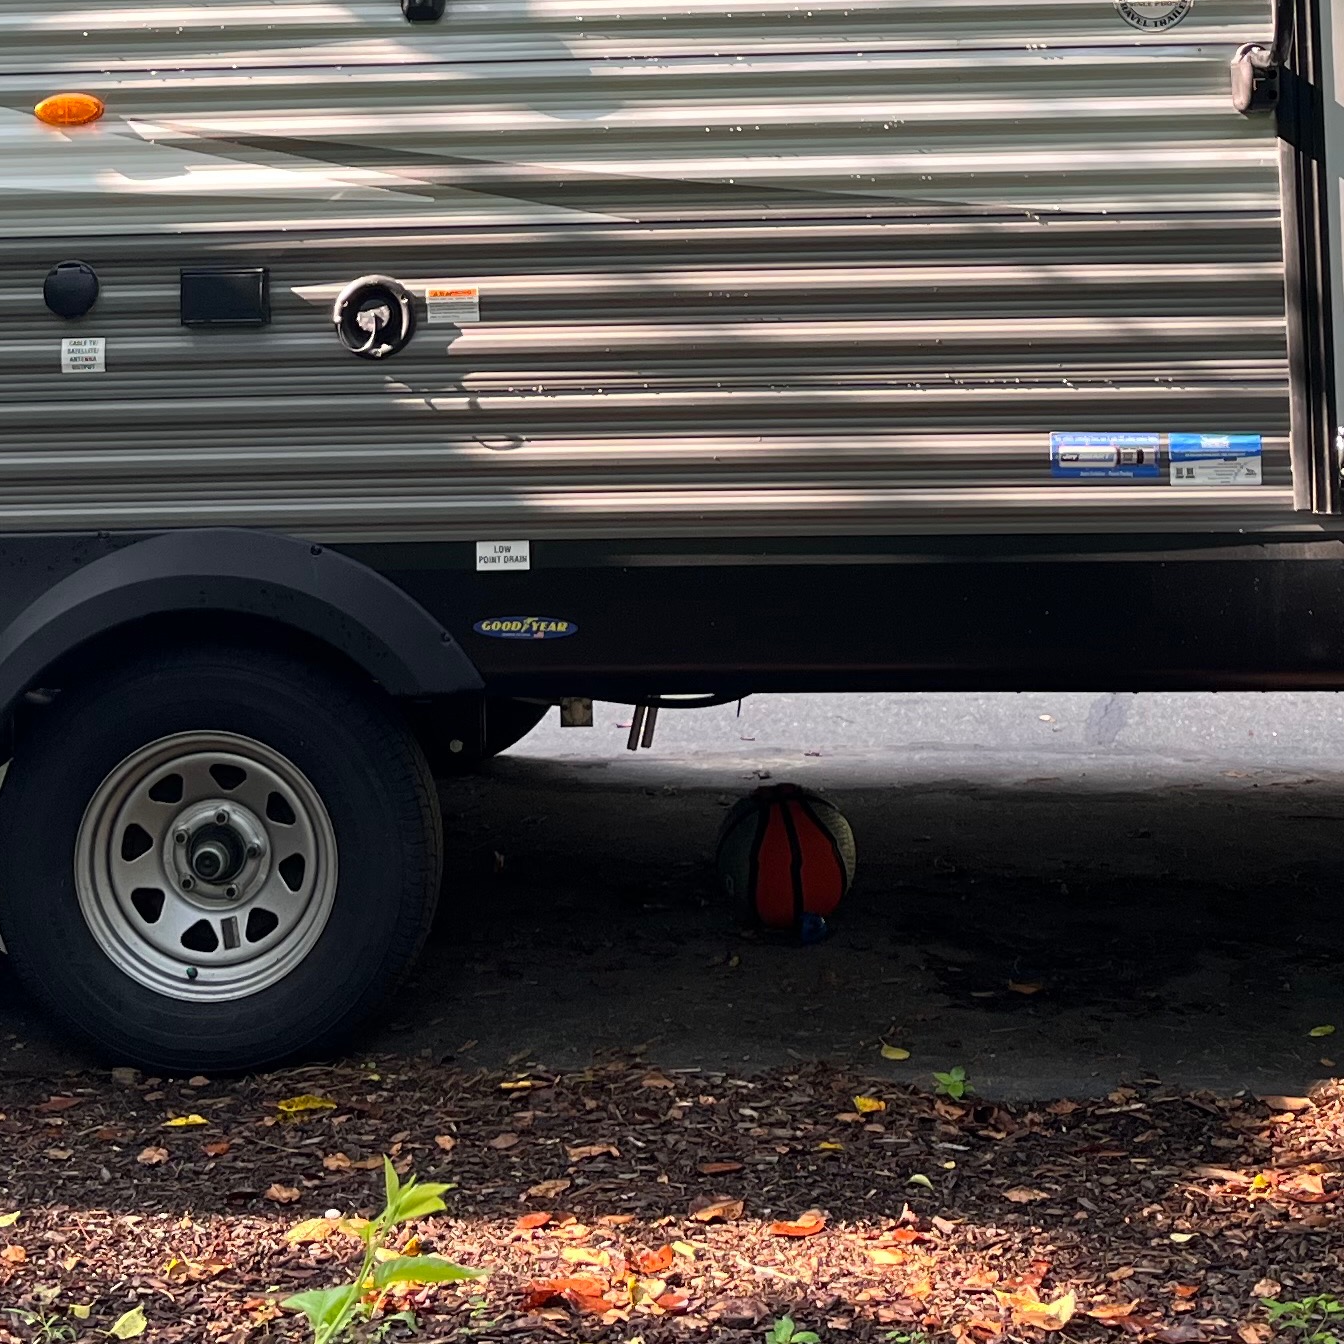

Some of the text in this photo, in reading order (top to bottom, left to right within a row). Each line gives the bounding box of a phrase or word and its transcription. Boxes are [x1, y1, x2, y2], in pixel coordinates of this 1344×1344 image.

[493, 545, 512, 554] LOW
[478, 555, 528, 564] POINT DRAIN
